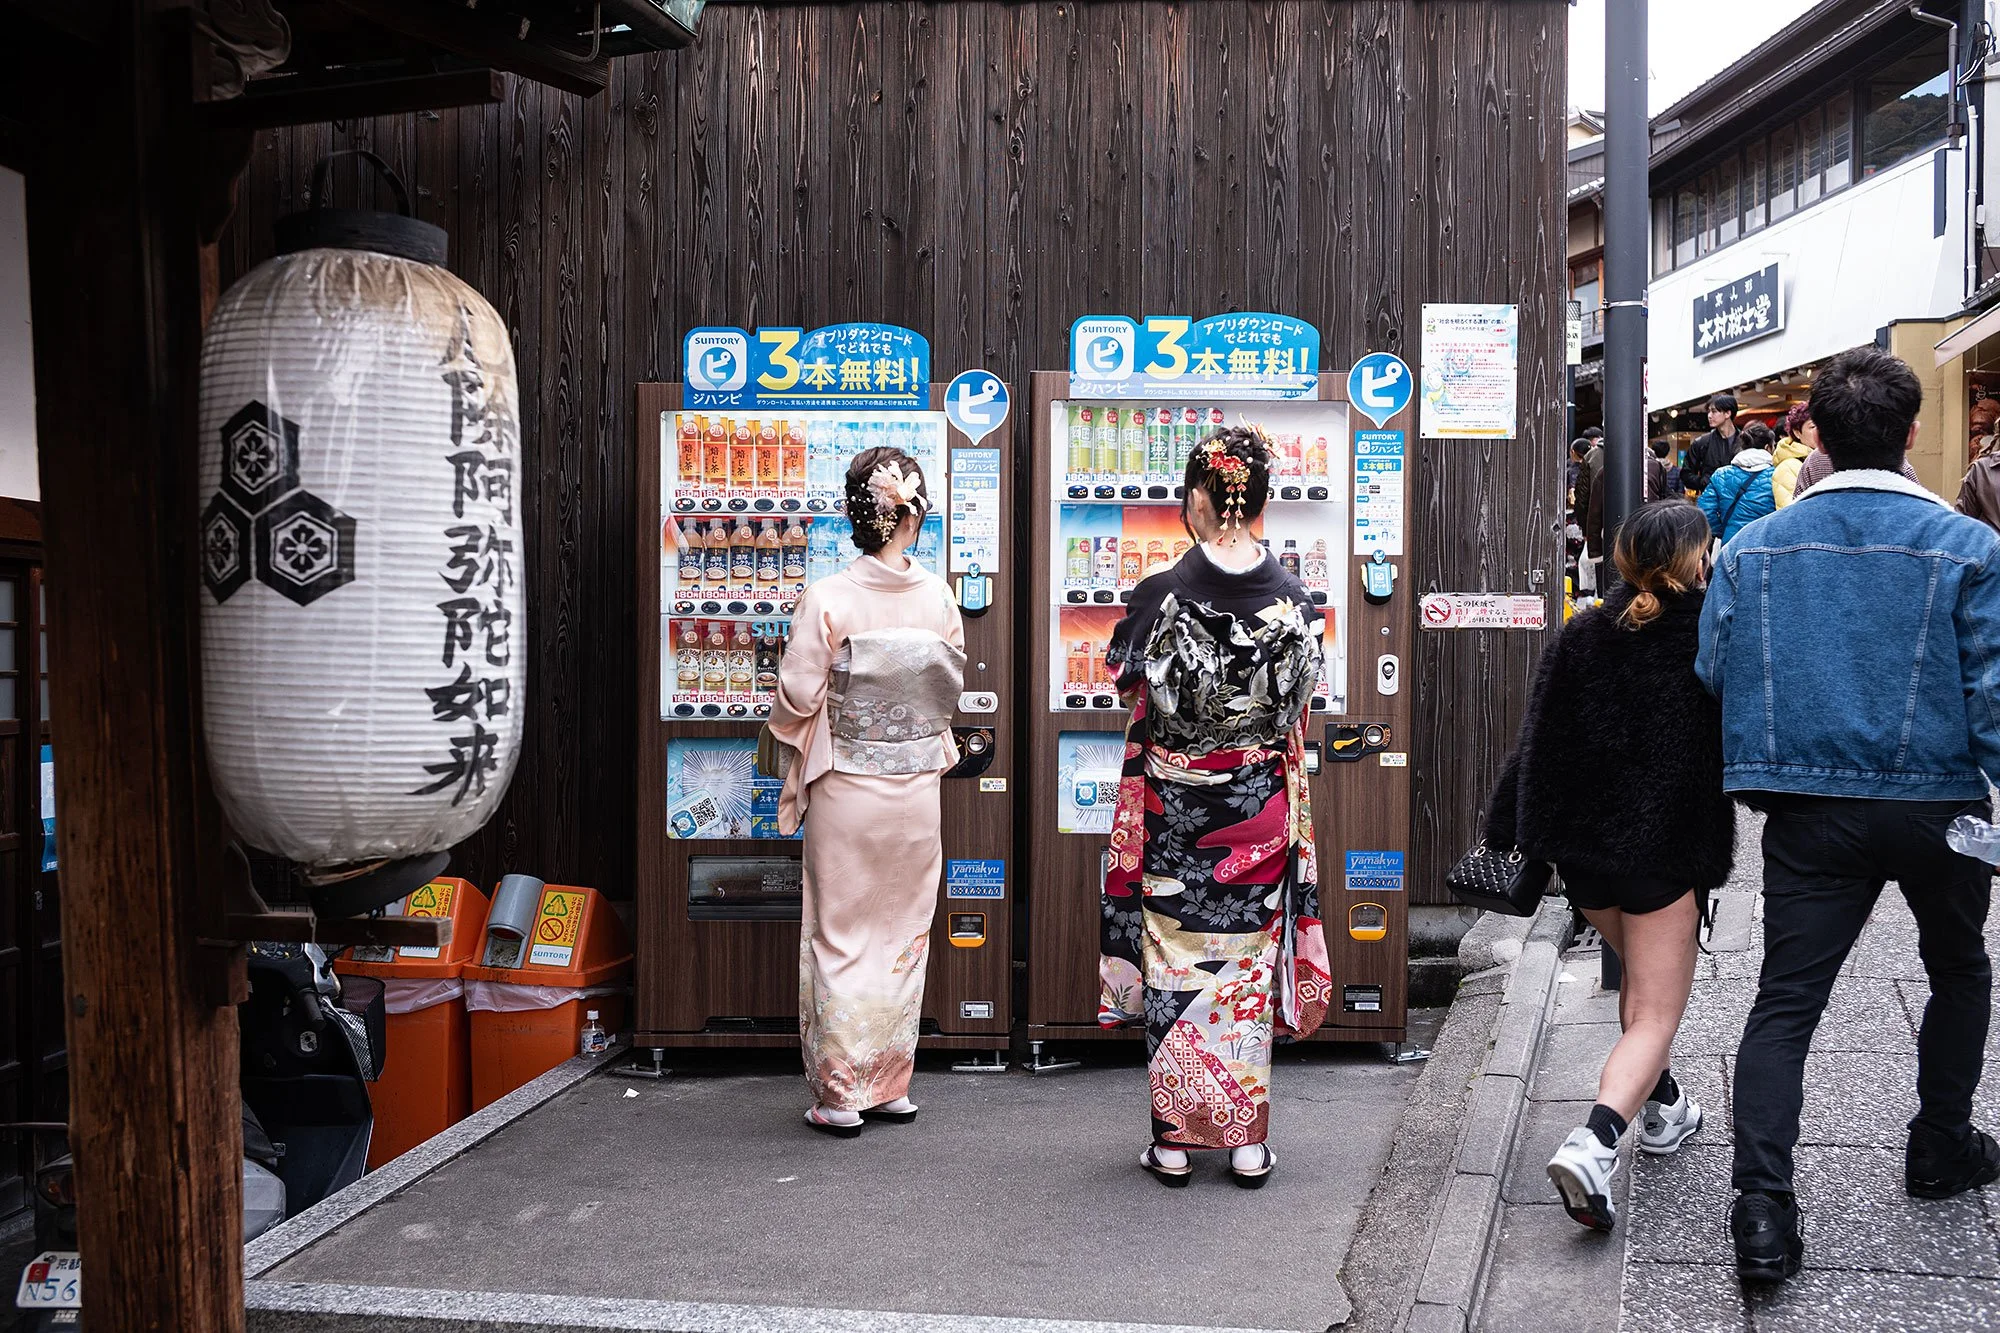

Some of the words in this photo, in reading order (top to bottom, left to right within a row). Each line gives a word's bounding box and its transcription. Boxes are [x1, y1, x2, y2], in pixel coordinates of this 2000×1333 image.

[1715, 278, 1753, 307] 京人形
[1204, 317, 1304, 336] アプリダウンロード
[1697, 293, 1771, 349] 木村桜士堂
[813, 328, 913, 346] アプリダウンロード
[1082, 325, 1128, 334] SUNTORY
[694, 336, 740, 345] SUNTORY
[1224, 332, 1283, 345] でどれでも
[835, 343, 893, 355] でどれでも
[1144, 319, 1310, 381] 3本無料!
[756, 331, 920, 392] 3本無料!
[1079, 382, 1130, 395] ジハンピ
[1361, 363, 1402, 408] ピ
[692, 393, 743, 405] ジハンピ
[958, 379, 1000, 425] ピ
[1361, 433, 1398, 441] SUNTORY
[1371, 445, 1402, 453] ジハンピ
[683, 443, 694, 471] 焙じ茶
[709, 446, 720, 473] 焙じ茶
[736, 449, 746, 477] 焙じ茶
[762, 449, 772, 477] 焙じ茶
[789, 449, 799, 477] 焙じ茶
[967, 463, 998, 471] ジハンピ
[1118, 578, 1137, 586] 160
[780, 591, 798, 599] 180
[1456, 600, 1496, 608] この区域で
[1513, 616, 1542, 625] ¥1,000
[760, 795, 778, 803] スキャ
[1351, 852, 1399, 870] yamakyu
[952, 861, 1000, 878] yamakyu
[532, 950, 571, 961] SUNTORY
